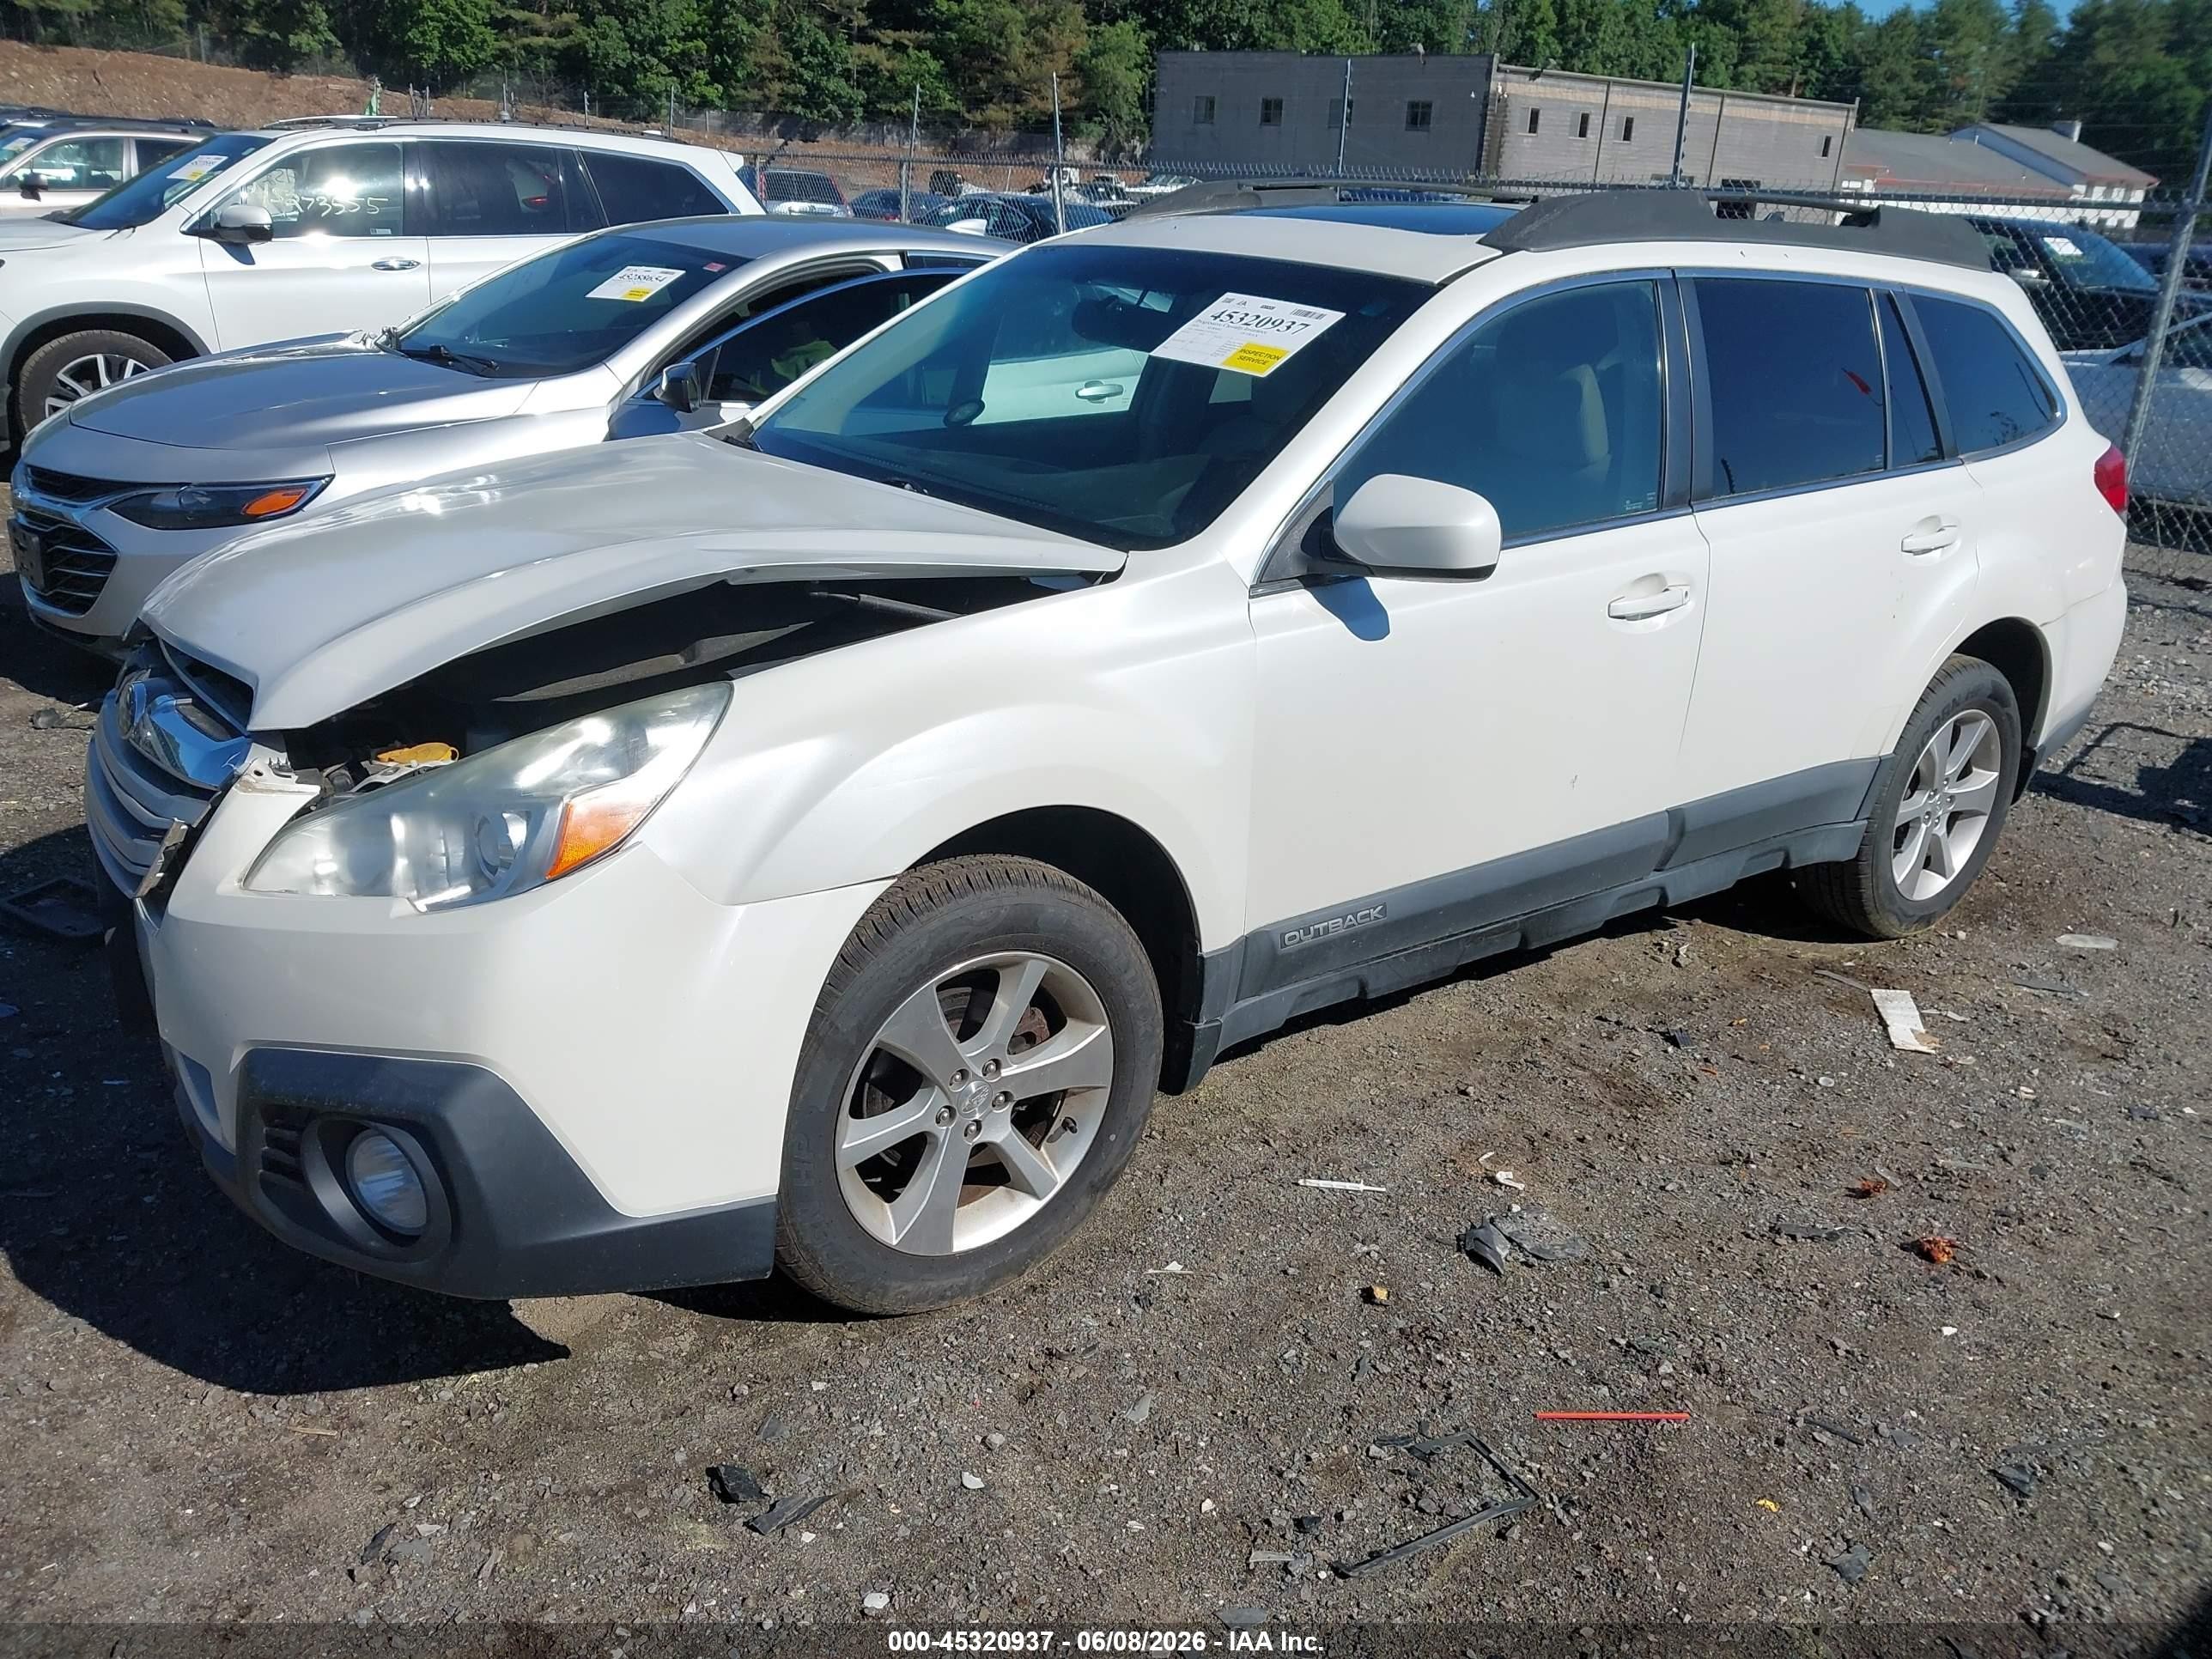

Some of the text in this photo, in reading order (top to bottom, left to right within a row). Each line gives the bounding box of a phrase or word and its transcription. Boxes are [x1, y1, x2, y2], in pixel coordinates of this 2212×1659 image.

[1210, 308, 1311, 336] 45320937
[1237, 355, 1270, 366] SERVICE
[1239, 348, 1282, 361] INSPECTION
[1284, 904, 1385, 945] OUTBACK
